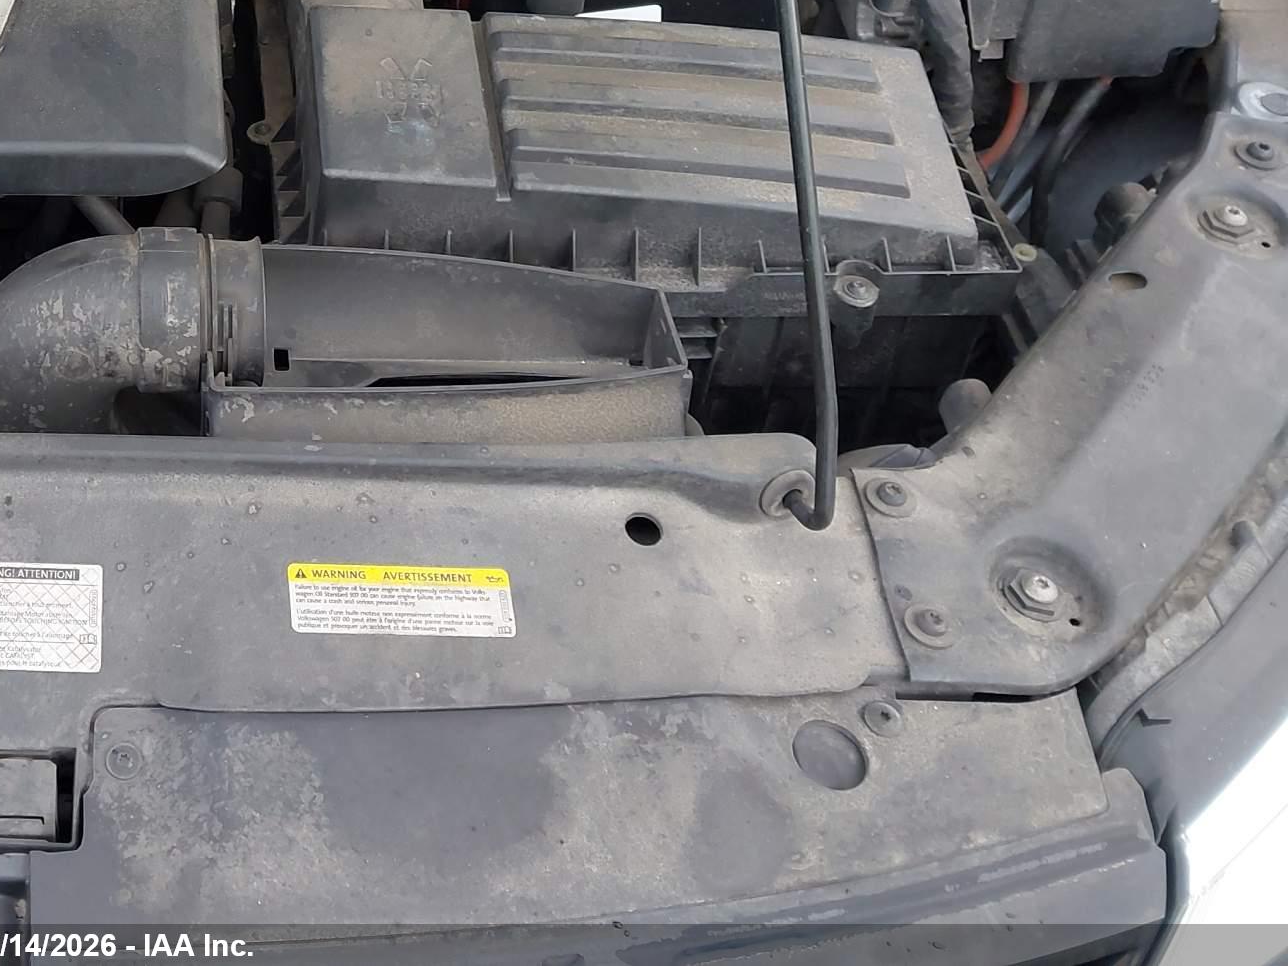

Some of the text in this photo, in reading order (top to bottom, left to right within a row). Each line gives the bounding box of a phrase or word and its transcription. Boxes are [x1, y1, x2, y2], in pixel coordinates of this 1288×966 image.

[17, 569, 77, 580] ATTENTION!
[311, 569, 472, 583] WARNING AVERTISSEMENT
